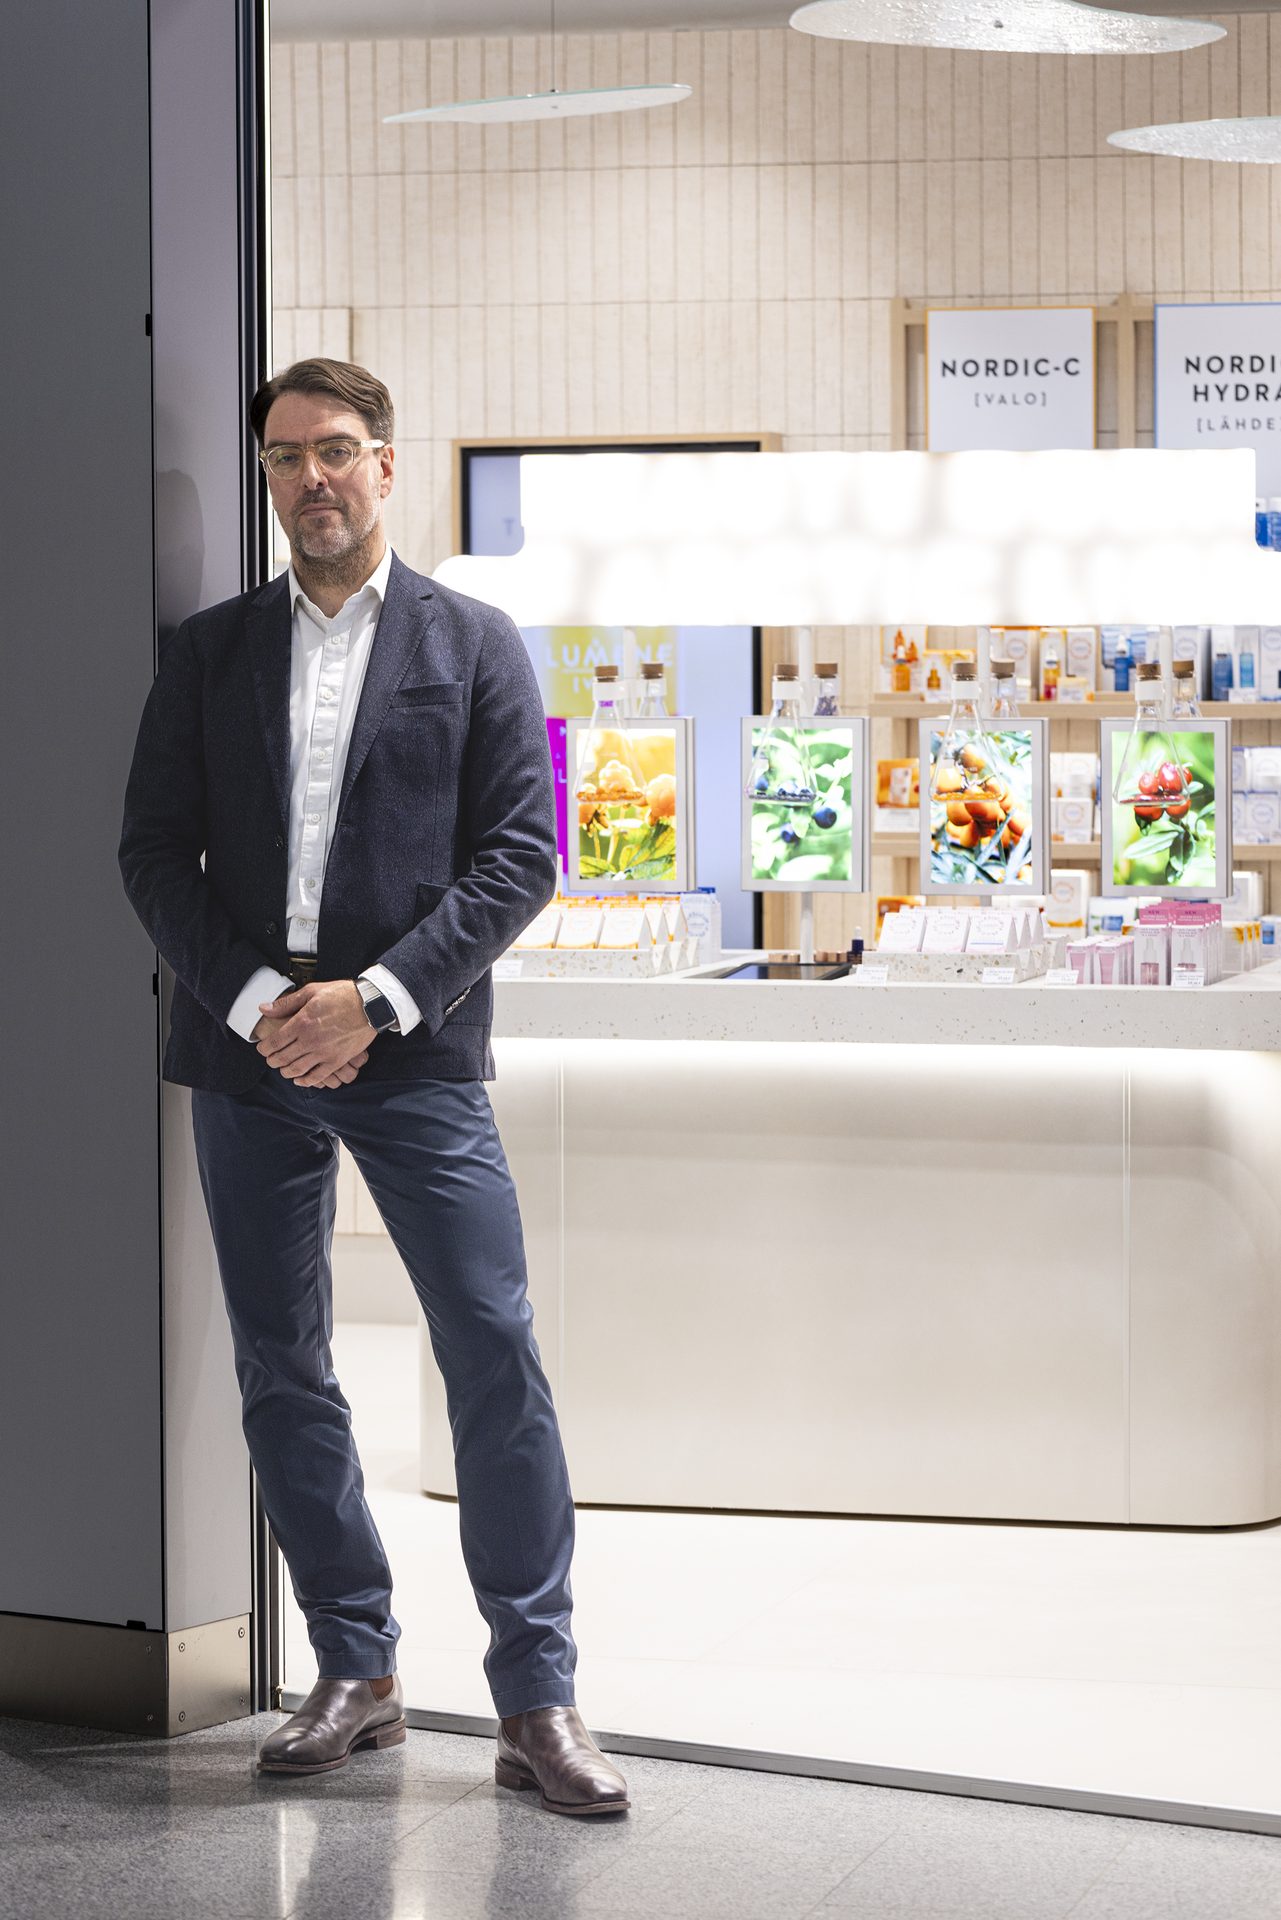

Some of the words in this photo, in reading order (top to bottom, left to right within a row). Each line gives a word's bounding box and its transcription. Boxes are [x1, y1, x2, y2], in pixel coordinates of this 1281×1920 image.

[941, 357, 1081, 378] NORDIC-C
[1185, 354, 1281, 374] NORDI
[974, 392, 1047, 408] [VALO]
